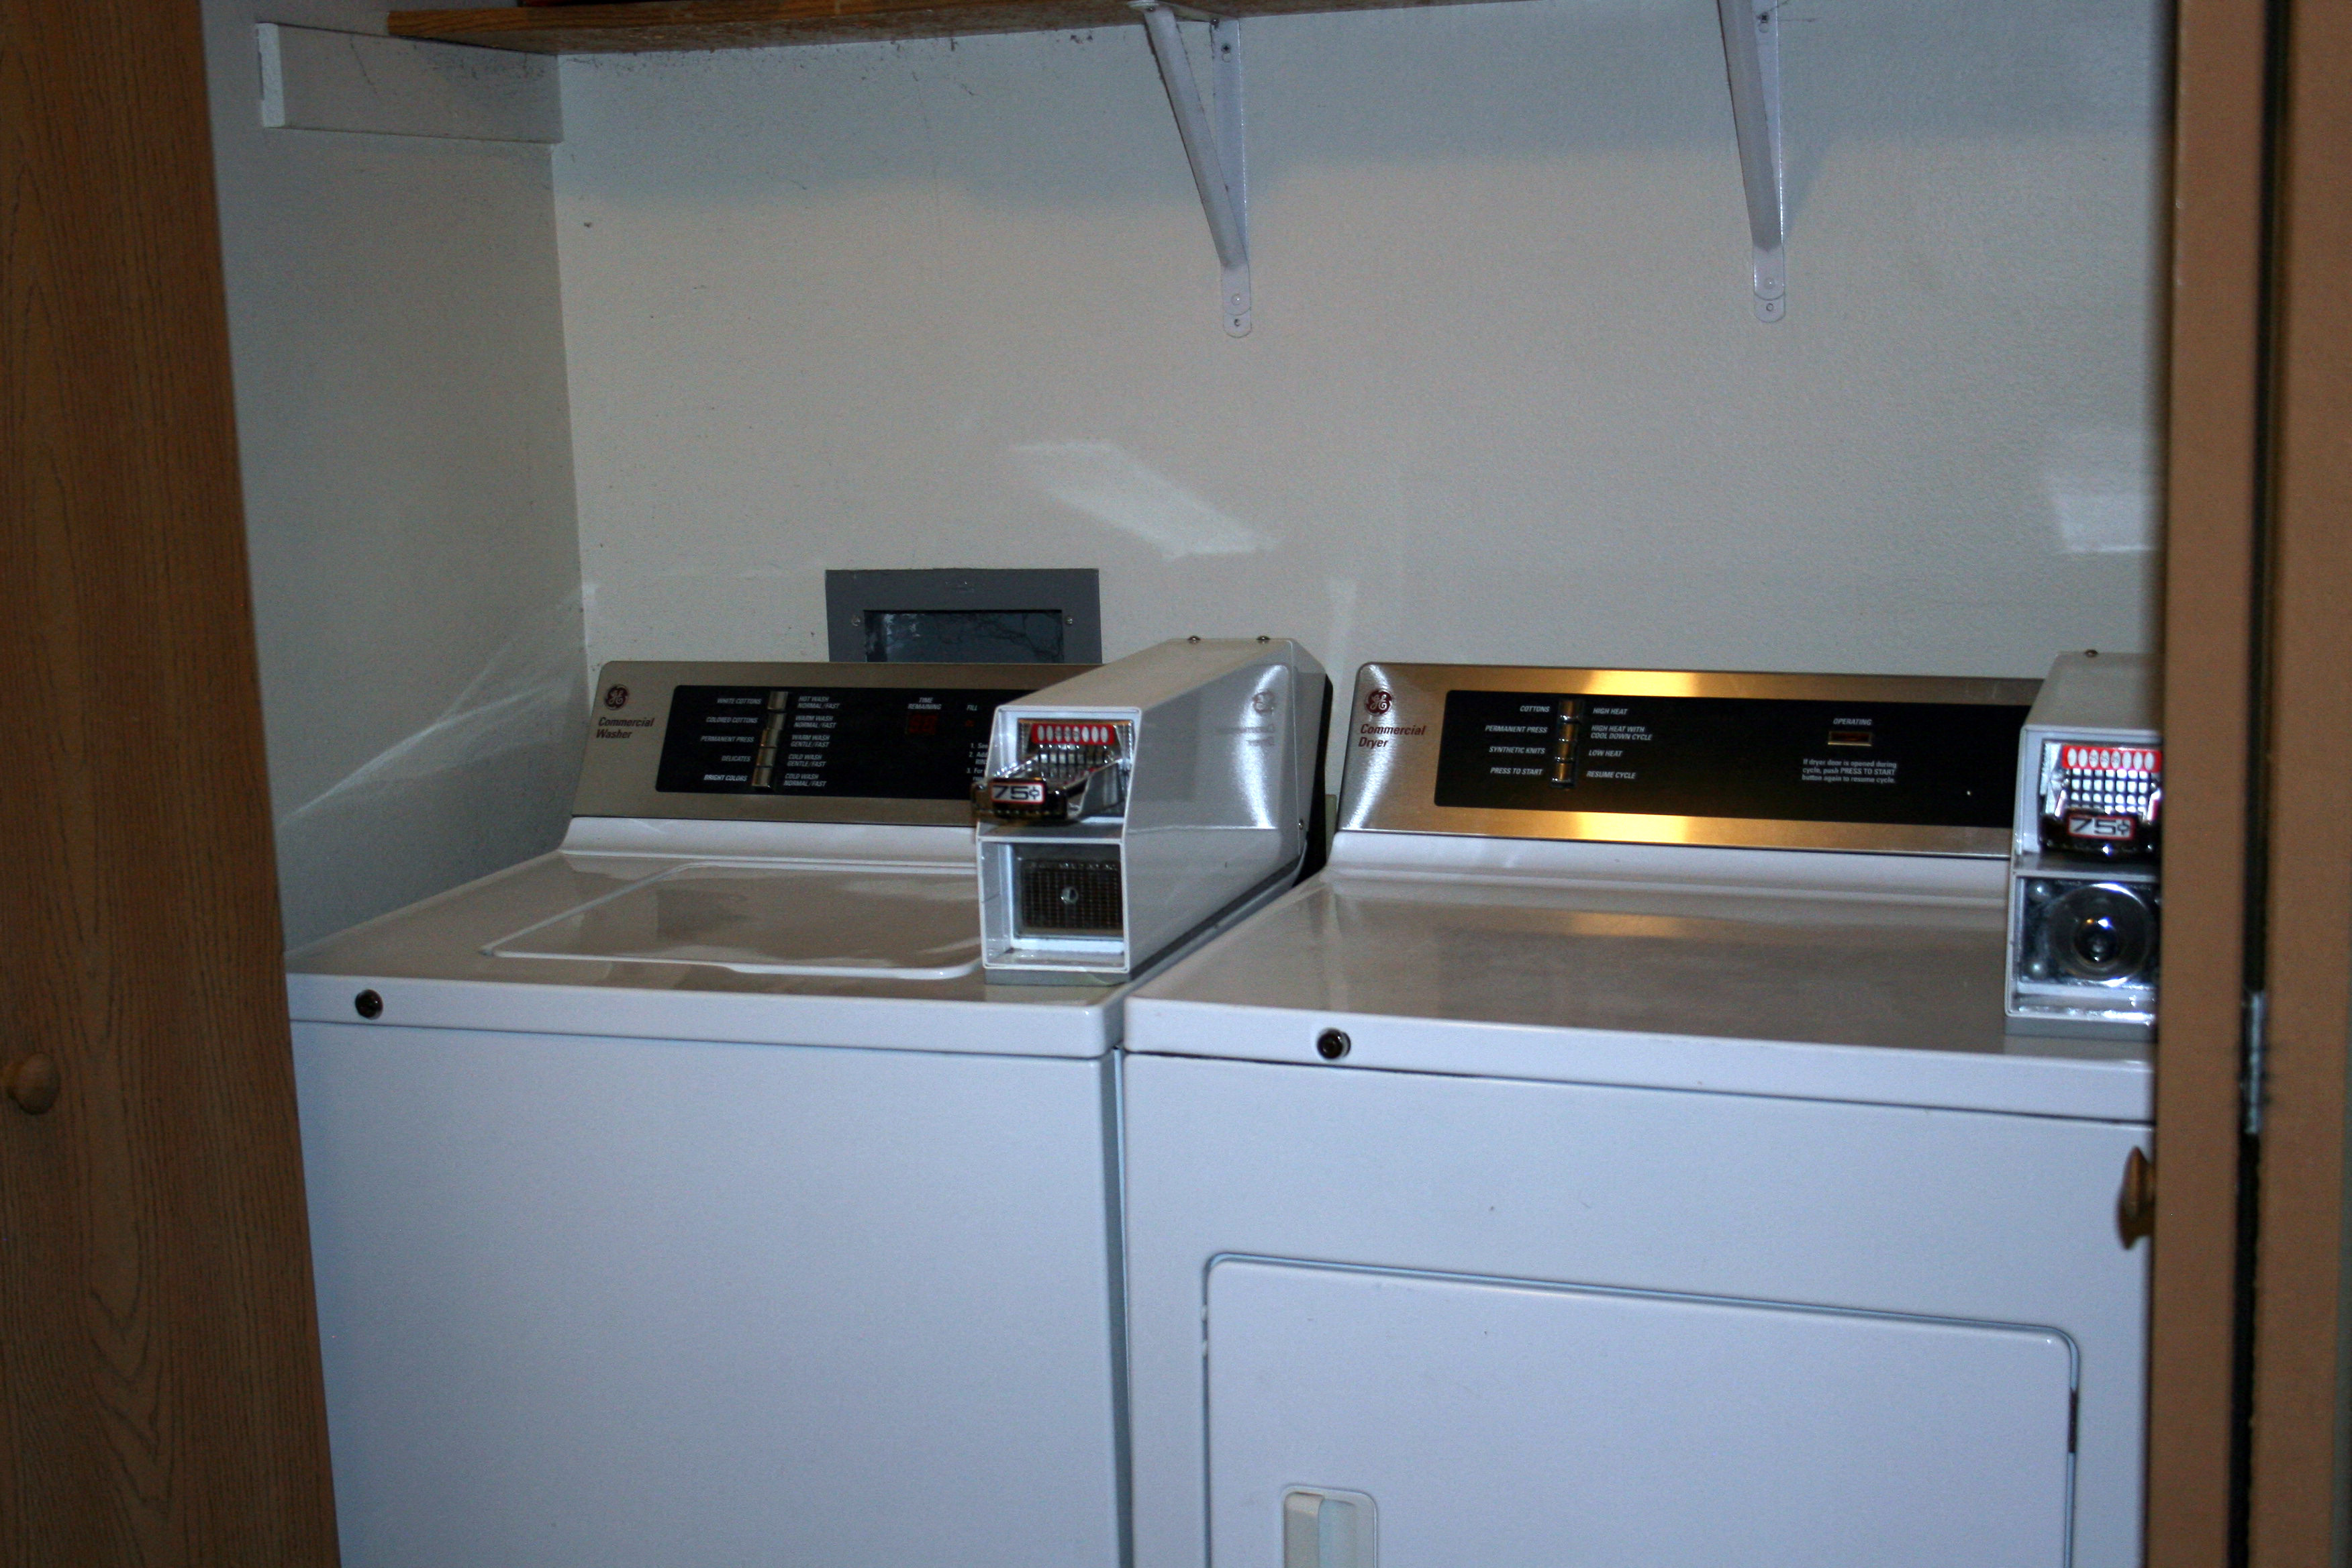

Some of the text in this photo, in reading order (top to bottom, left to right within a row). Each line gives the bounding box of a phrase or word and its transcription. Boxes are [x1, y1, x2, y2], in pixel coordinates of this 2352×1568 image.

[1365, 690, 1392, 716] GE
[1592, 707, 1628, 716] HIGH HEAT
[599, 717, 655, 726] Commercial
[1832, 718, 1873, 726] OPERATING
[596, 729, 632, 738] Washer
[1361, 724, 1427, 736] Commercial
[1484, 725, 1549, 734] PERMANENT PRESS
[1358, 736, 1389, 750] Dryer
[1488, 746, 1525, 754] SYNTHETIC
[1808, 758, 1826, 767] dryer
[1850, 760, 1875, 768] opened
[1875, 761, 1898, 769] during
[1585, 771, 1637, 779] RESUME CYCLE
[1822, 774, 1842, 783] again
[993, 785, 1040, 800] 75¢
[2070, 818, 2130, 836] 75¢
